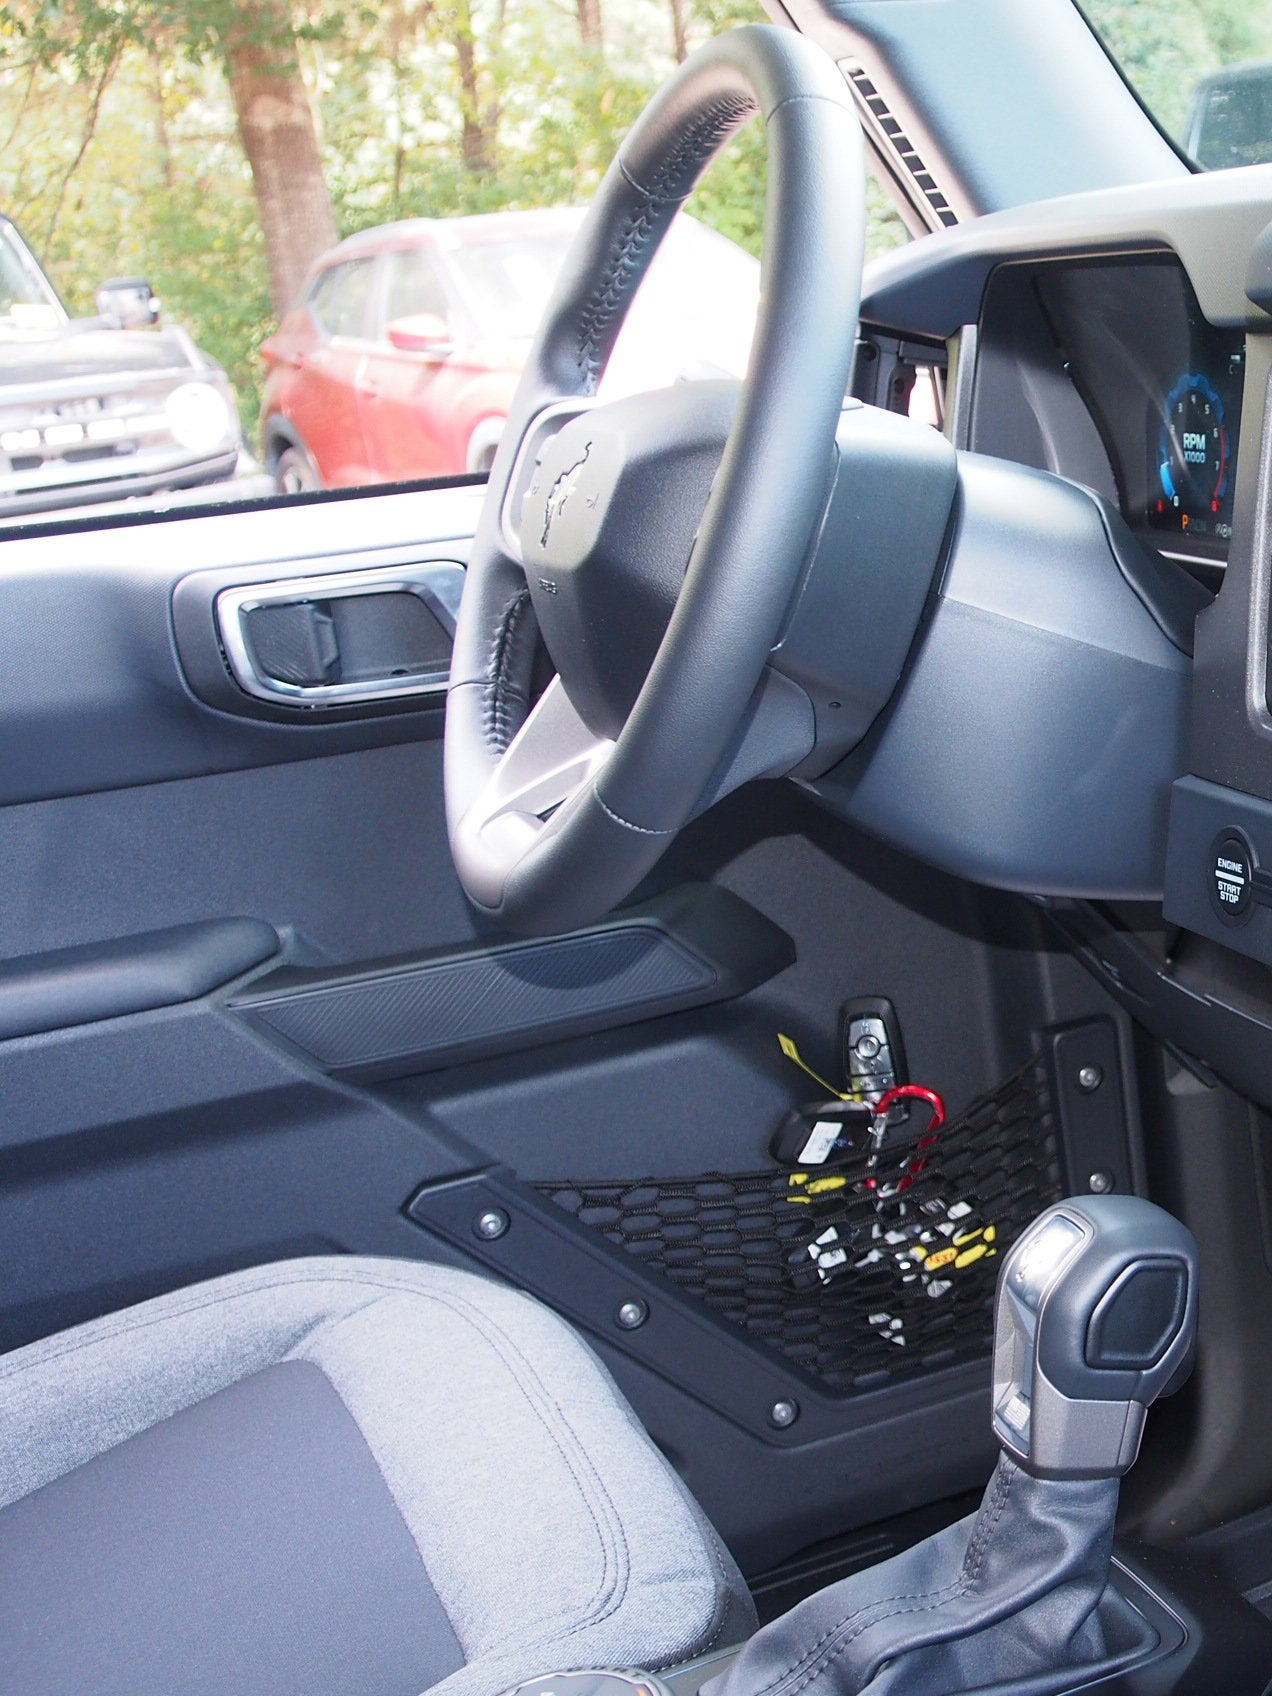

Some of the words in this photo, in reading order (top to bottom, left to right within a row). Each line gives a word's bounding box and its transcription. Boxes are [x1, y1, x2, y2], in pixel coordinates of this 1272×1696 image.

[1205, 403, 1210, 415] 5
[1183, 432, 1206, 450] RPM
[1182, 513, 1189, 530] P
[1217, 857, 1243, 874] ENGINE
[1218, 880, 1242, 896] START
[1220, 890, 1239, 904] STOP
